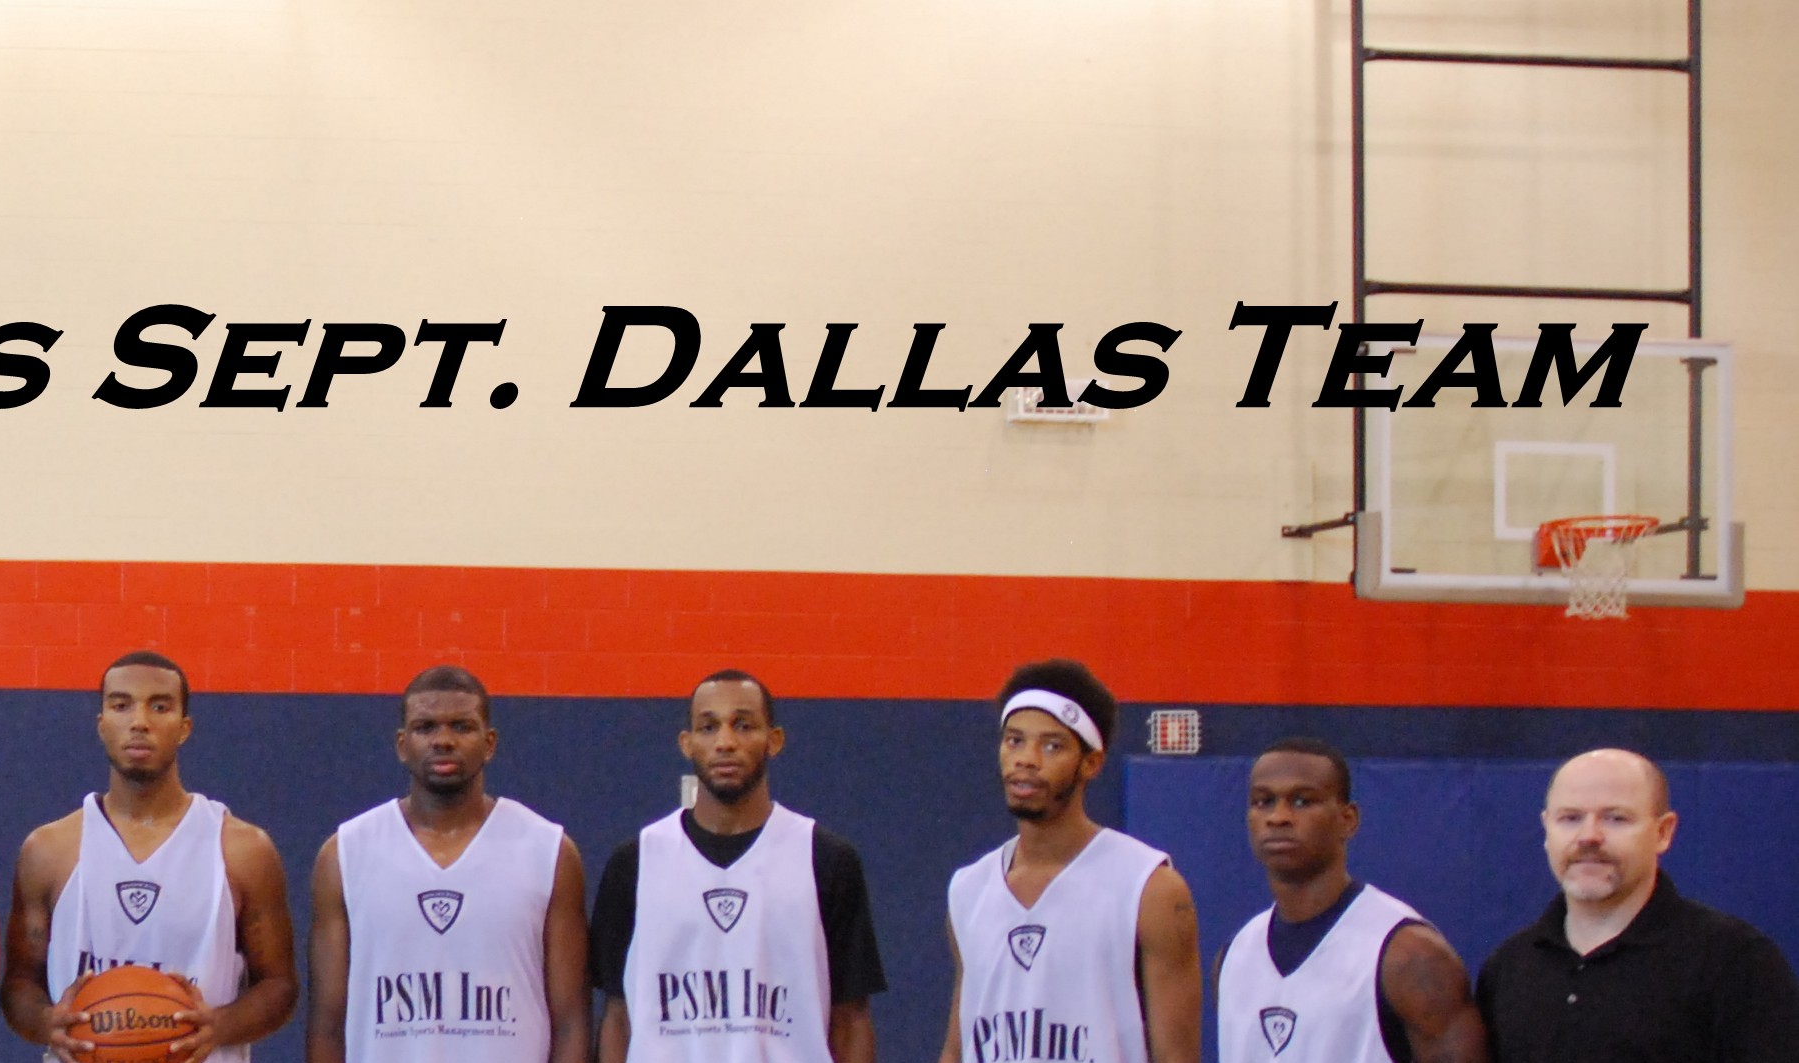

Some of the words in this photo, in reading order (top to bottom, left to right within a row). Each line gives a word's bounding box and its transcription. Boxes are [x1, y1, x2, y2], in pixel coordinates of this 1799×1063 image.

[90, 1007, 179, 1035] Wilson
[375, 971, 443, 1024] PSM
[459, 972, 517, 1023] Inc.
[658, 970, 729, 1022] PSM
[743, 968, 793, 1024] Inc.
[1030, 1007, 1095, 1063] Inc.
